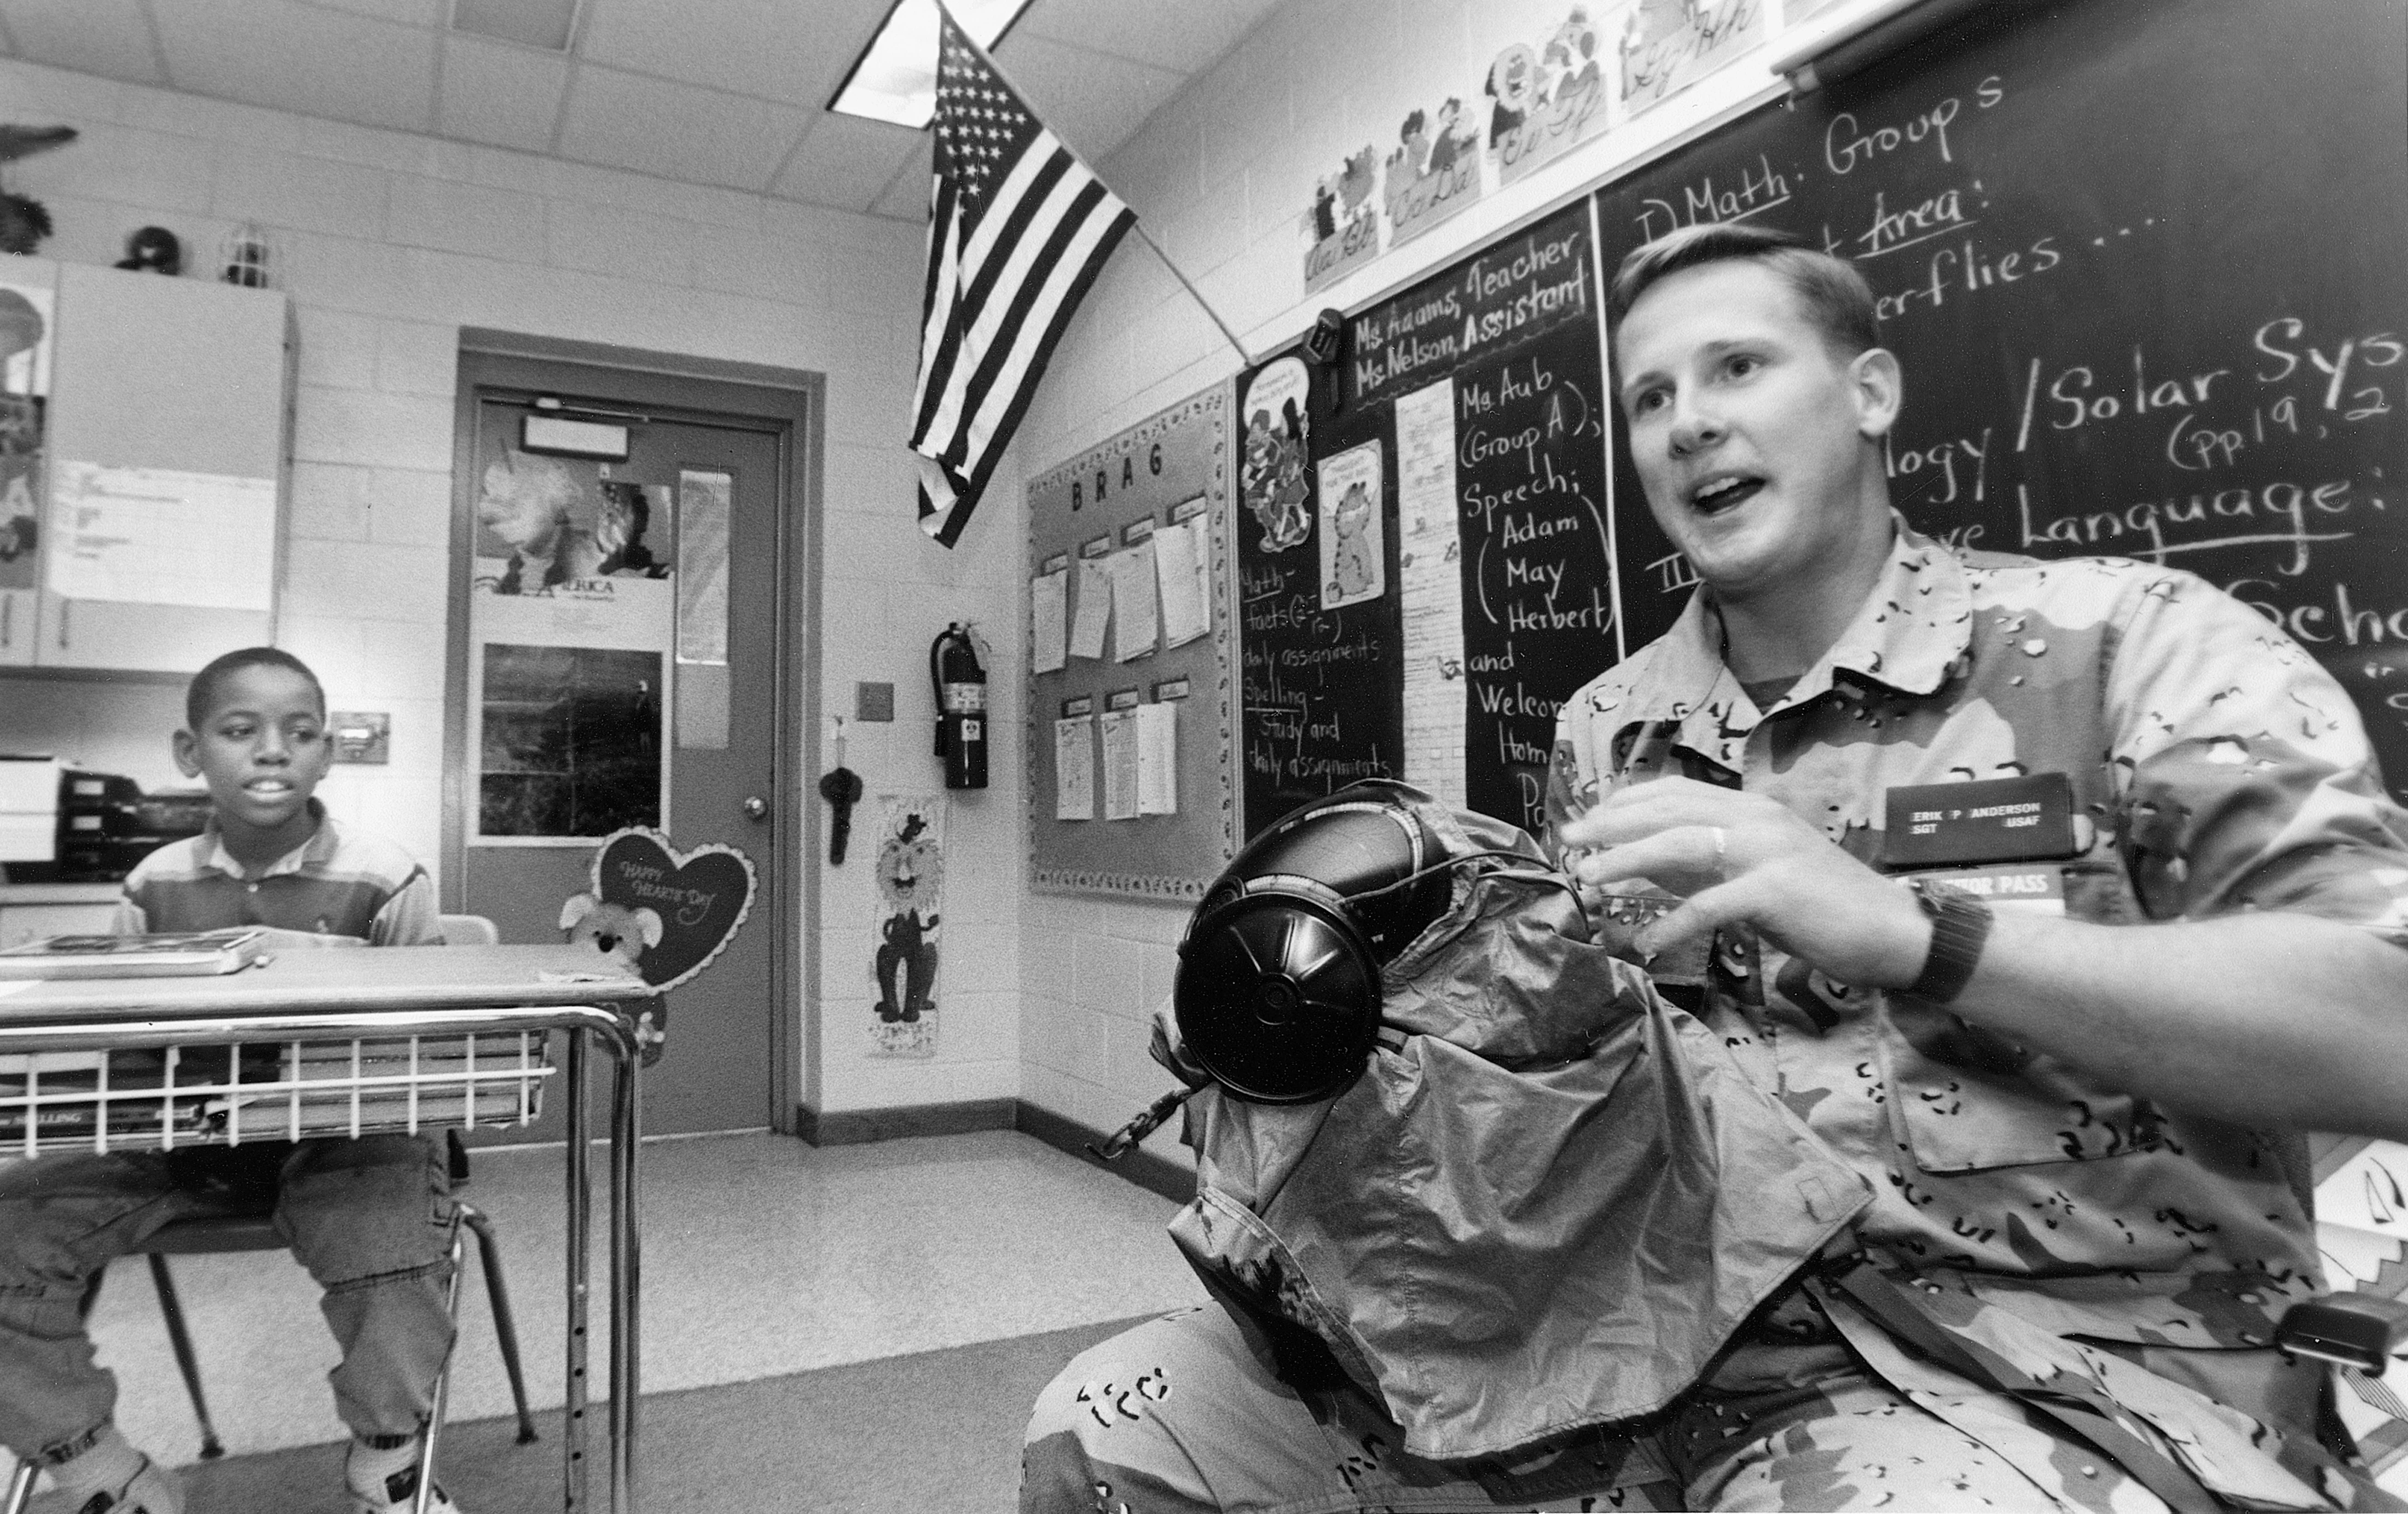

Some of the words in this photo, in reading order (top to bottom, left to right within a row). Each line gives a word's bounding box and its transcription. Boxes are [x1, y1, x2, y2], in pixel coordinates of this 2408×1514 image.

[1857, 179, 1990, 252] Area:
[1387, 287, 1461, 341] Adams,
[1466, 231, 1579, 302] Teacher
[1875, 237, 2062, 322] erflies
[1387, 335, 1460, 379] Nelson,
[1463, 256, 1586, 352] Assistant
[1500, 356, 1553, 407] Aub
[1071, 443, 1162, 512] BRAG
[1886, 427, 1992, 503] logy
[1502, 511, 1579, 548] Adam
[2018, 466, 2386, 576] Language:
[1506, 556, 1566, 600] May
[1469, 641, 1515, 672] and
[1498, 720, 1548, 764] Hom
[1912, 823, 1938, 835] SGT
[2005, 815, 2041, 828] USAF
[1913, 811, 1943, 822] ERIK
[1952, 809, 1961, 820] P
[1970, 802, 2041, 819] ANDERSON
[1999, 874, 2048, 893] PASS
